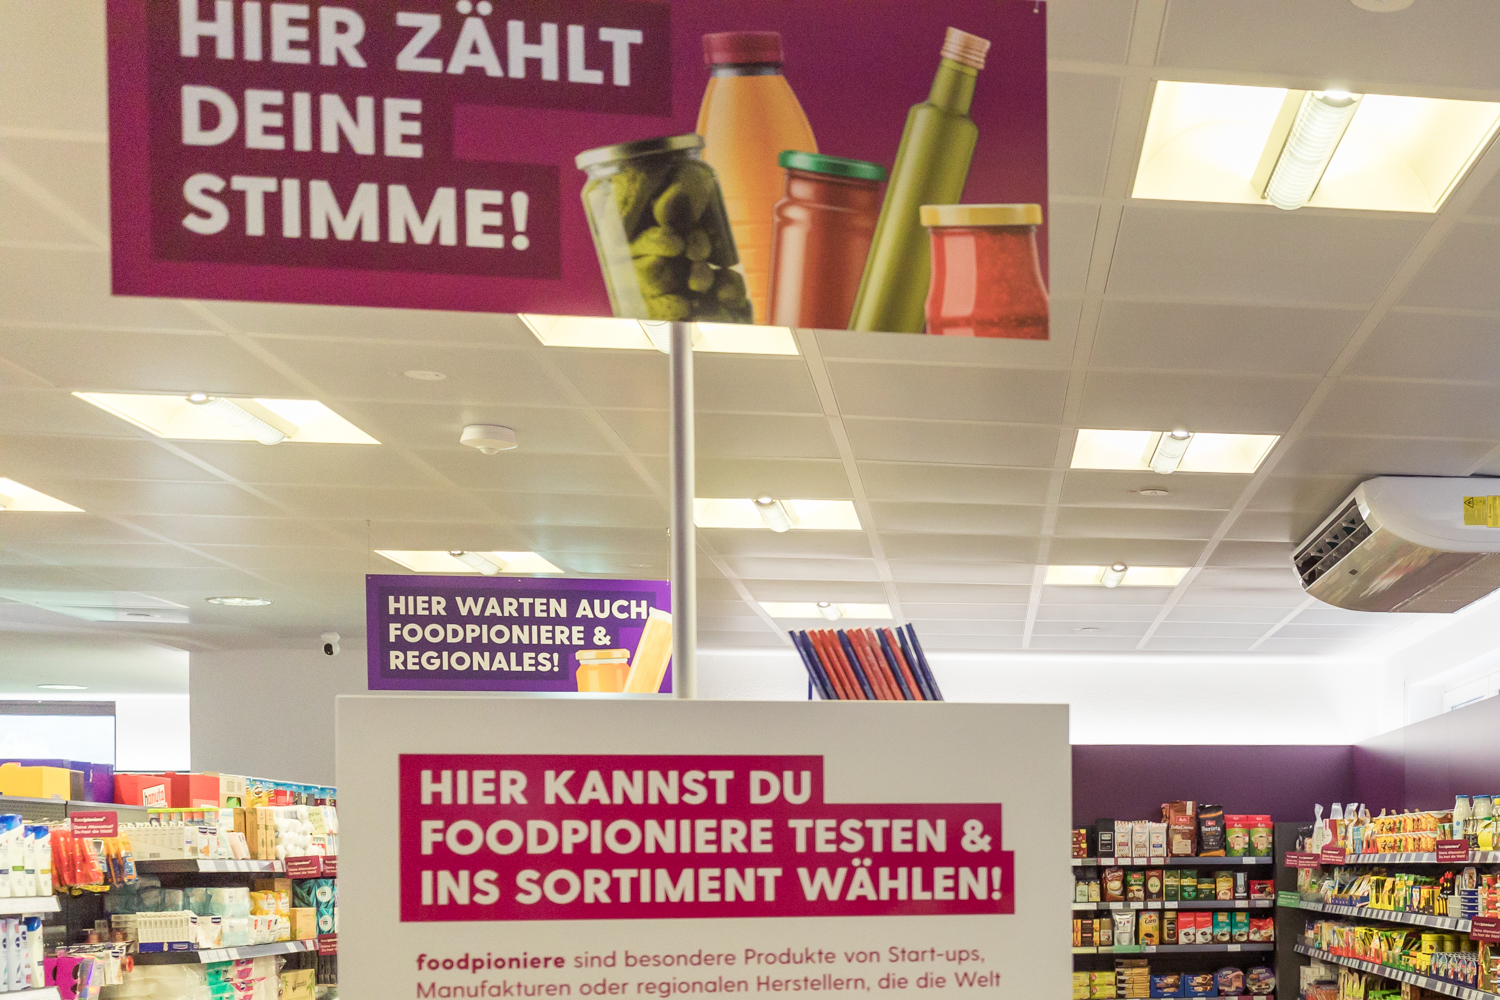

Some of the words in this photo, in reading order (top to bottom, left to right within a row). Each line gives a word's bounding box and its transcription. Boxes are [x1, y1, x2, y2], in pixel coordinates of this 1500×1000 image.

[178, 0, 368, 68] HIER
[394, 0, 644, 87] ZÄHLT
[180, 84, 424, 159] DEINE
[180, 172, 531, 252] STIMME!
[388, 595, 447, 616] HIER
[456, 596, 568, 618] WARTEN
[575, 599, 648, 620] AUCH
[388, 622, 585, 645] FOODPIONIERE
[592, 626, 612, 646] &
[388, 650, 560, 672] REGIONALES!
[420, 769, 528, 805] HIER
[543, 769, 735, 805] KANNST
[749, 769, 812, 805] DU
[420, 818, 774, 855] FOODPIONIERE
[787, 818, 948, 853] TESTEN
[960, 818, 993, 853] &
[420, 868, 501, 906] INS
[514, 867, 783, 904] SORTIMENT
[796, 856, 1003, 901] WÄHLEN!
[416, 951, 566, 974] foodpioniere
[573, 950, 618, 968] sind
[624, 948, 737, 968] besondere
[744, 946, 837, 966] Produkte
[844, 950, 881, 964] von
[887, 946, 986, 966] Start-ups,
[416, 980, 572, 999] Manufakturen
[578, 977, 630, 996] oder
[636, 975, 750, 999] regionalen
[756, 973, 872, 994] Herstellern,
[877, 972, 909, 990] die
[915, 970, 947, 989] die
[953, 969, 1002, 989] Welt
